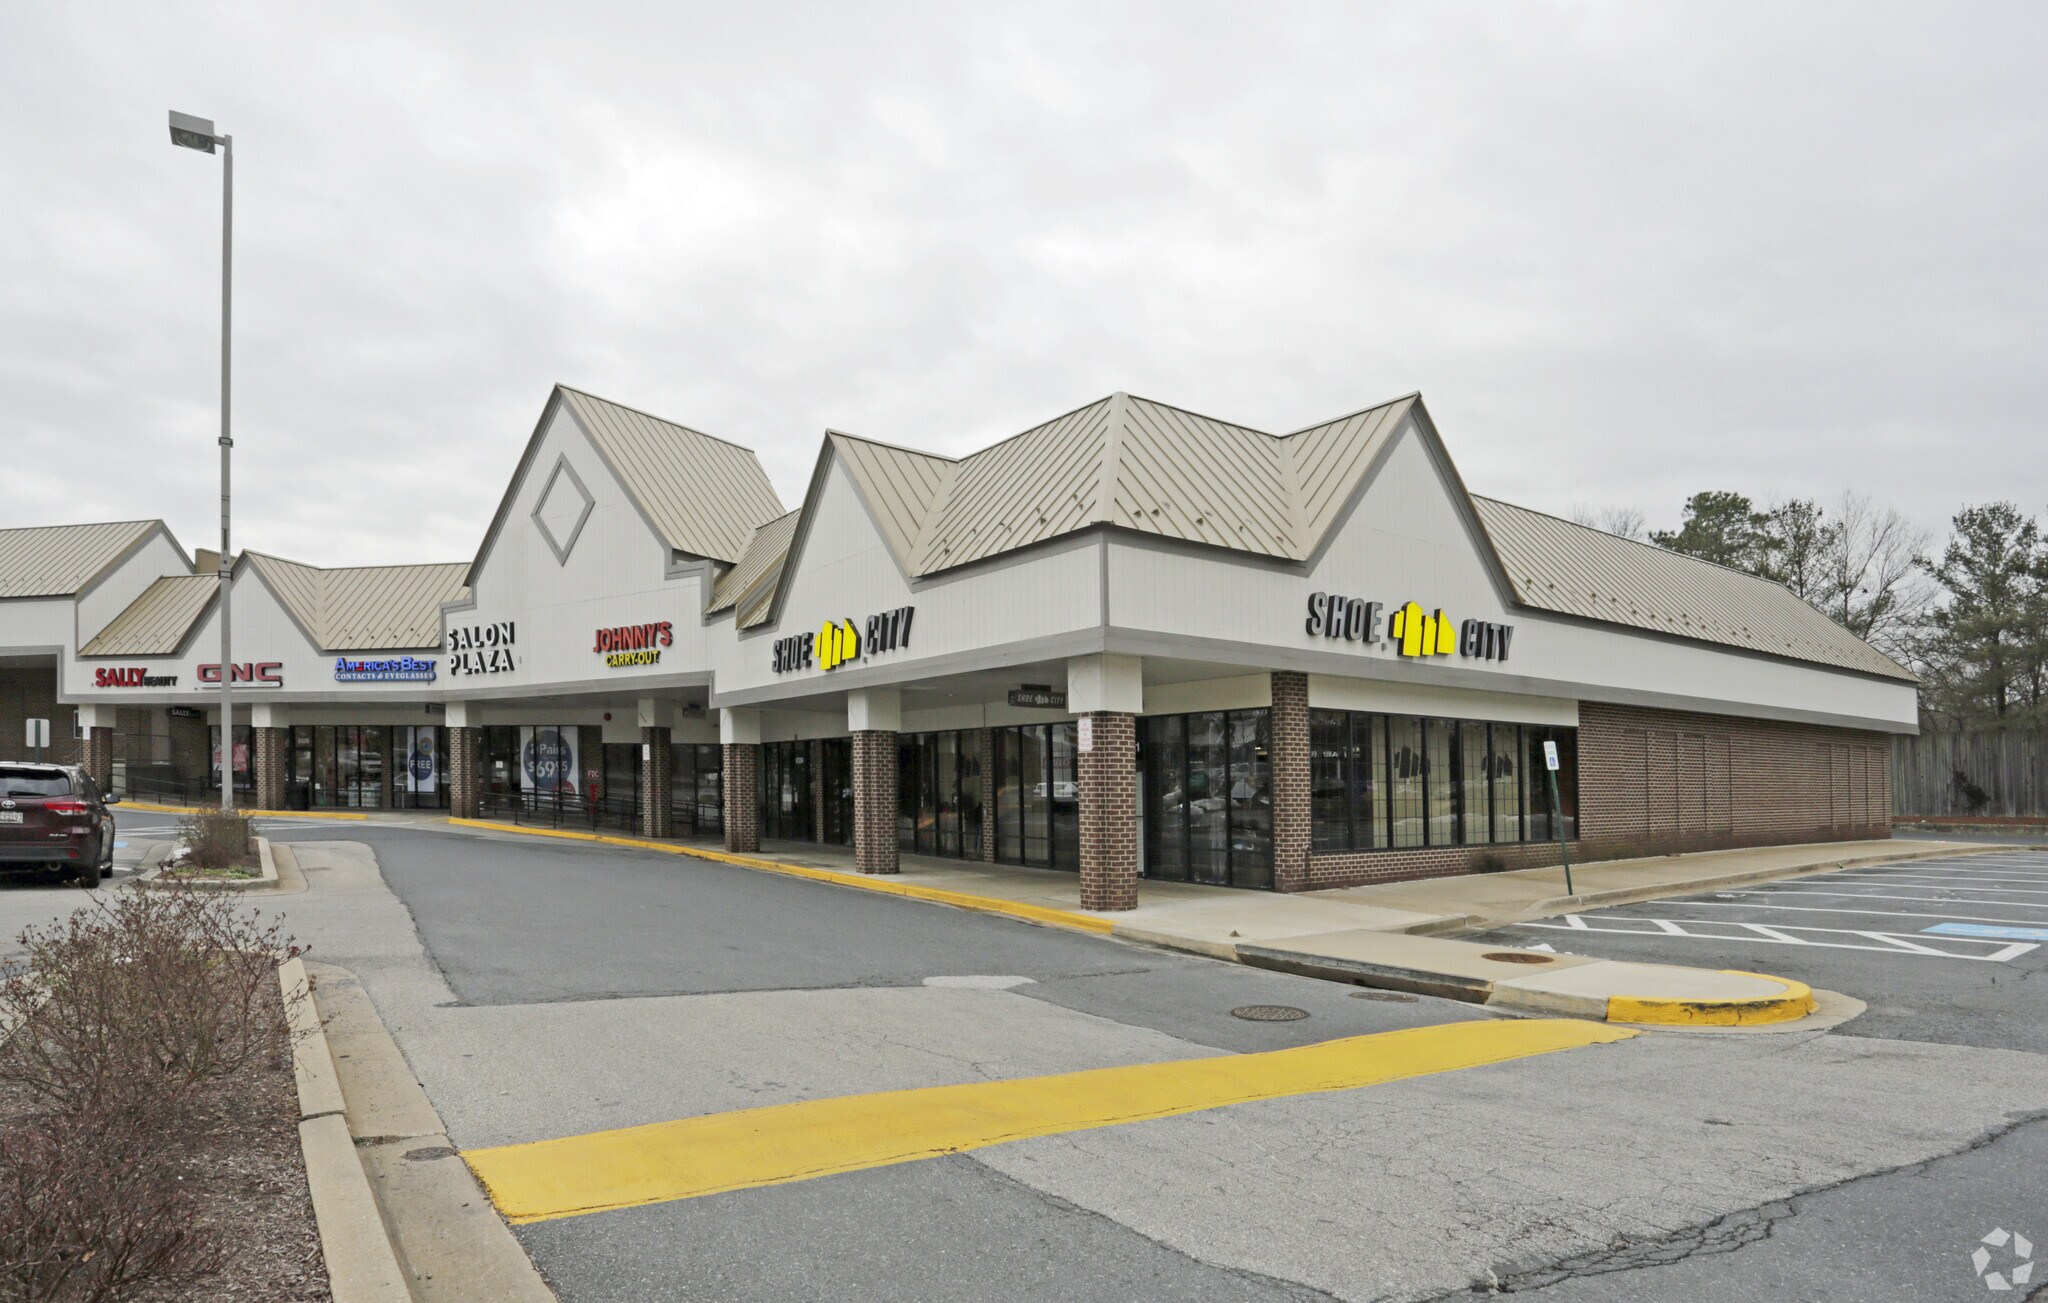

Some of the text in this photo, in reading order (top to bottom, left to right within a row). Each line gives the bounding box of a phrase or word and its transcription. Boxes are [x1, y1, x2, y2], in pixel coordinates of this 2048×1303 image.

[1305, 591, 1514, 661] SHOE CITY
[447, 621, 515, 651] SALON
[593, 621, 673, 654] JOHNNY'S
[772, 606, 915, 673] SHOE CITY
[400, 656, 436, 671] BEST
[450, 648, 515, 676] PLAZA
[606, 650, 661, 668] CARRY-OUT
[95, 668, 148, 687] SALLY
[197, 662, 282, 682] GNC
[1017, 694, 1064, 704] SHOE CITY
[171, 709, 190, 717] SALLY
[539, 743, 566, 755] Pairs
[410, 759, 431, 769] FREE
[588, 770, 599, 778] FDC
